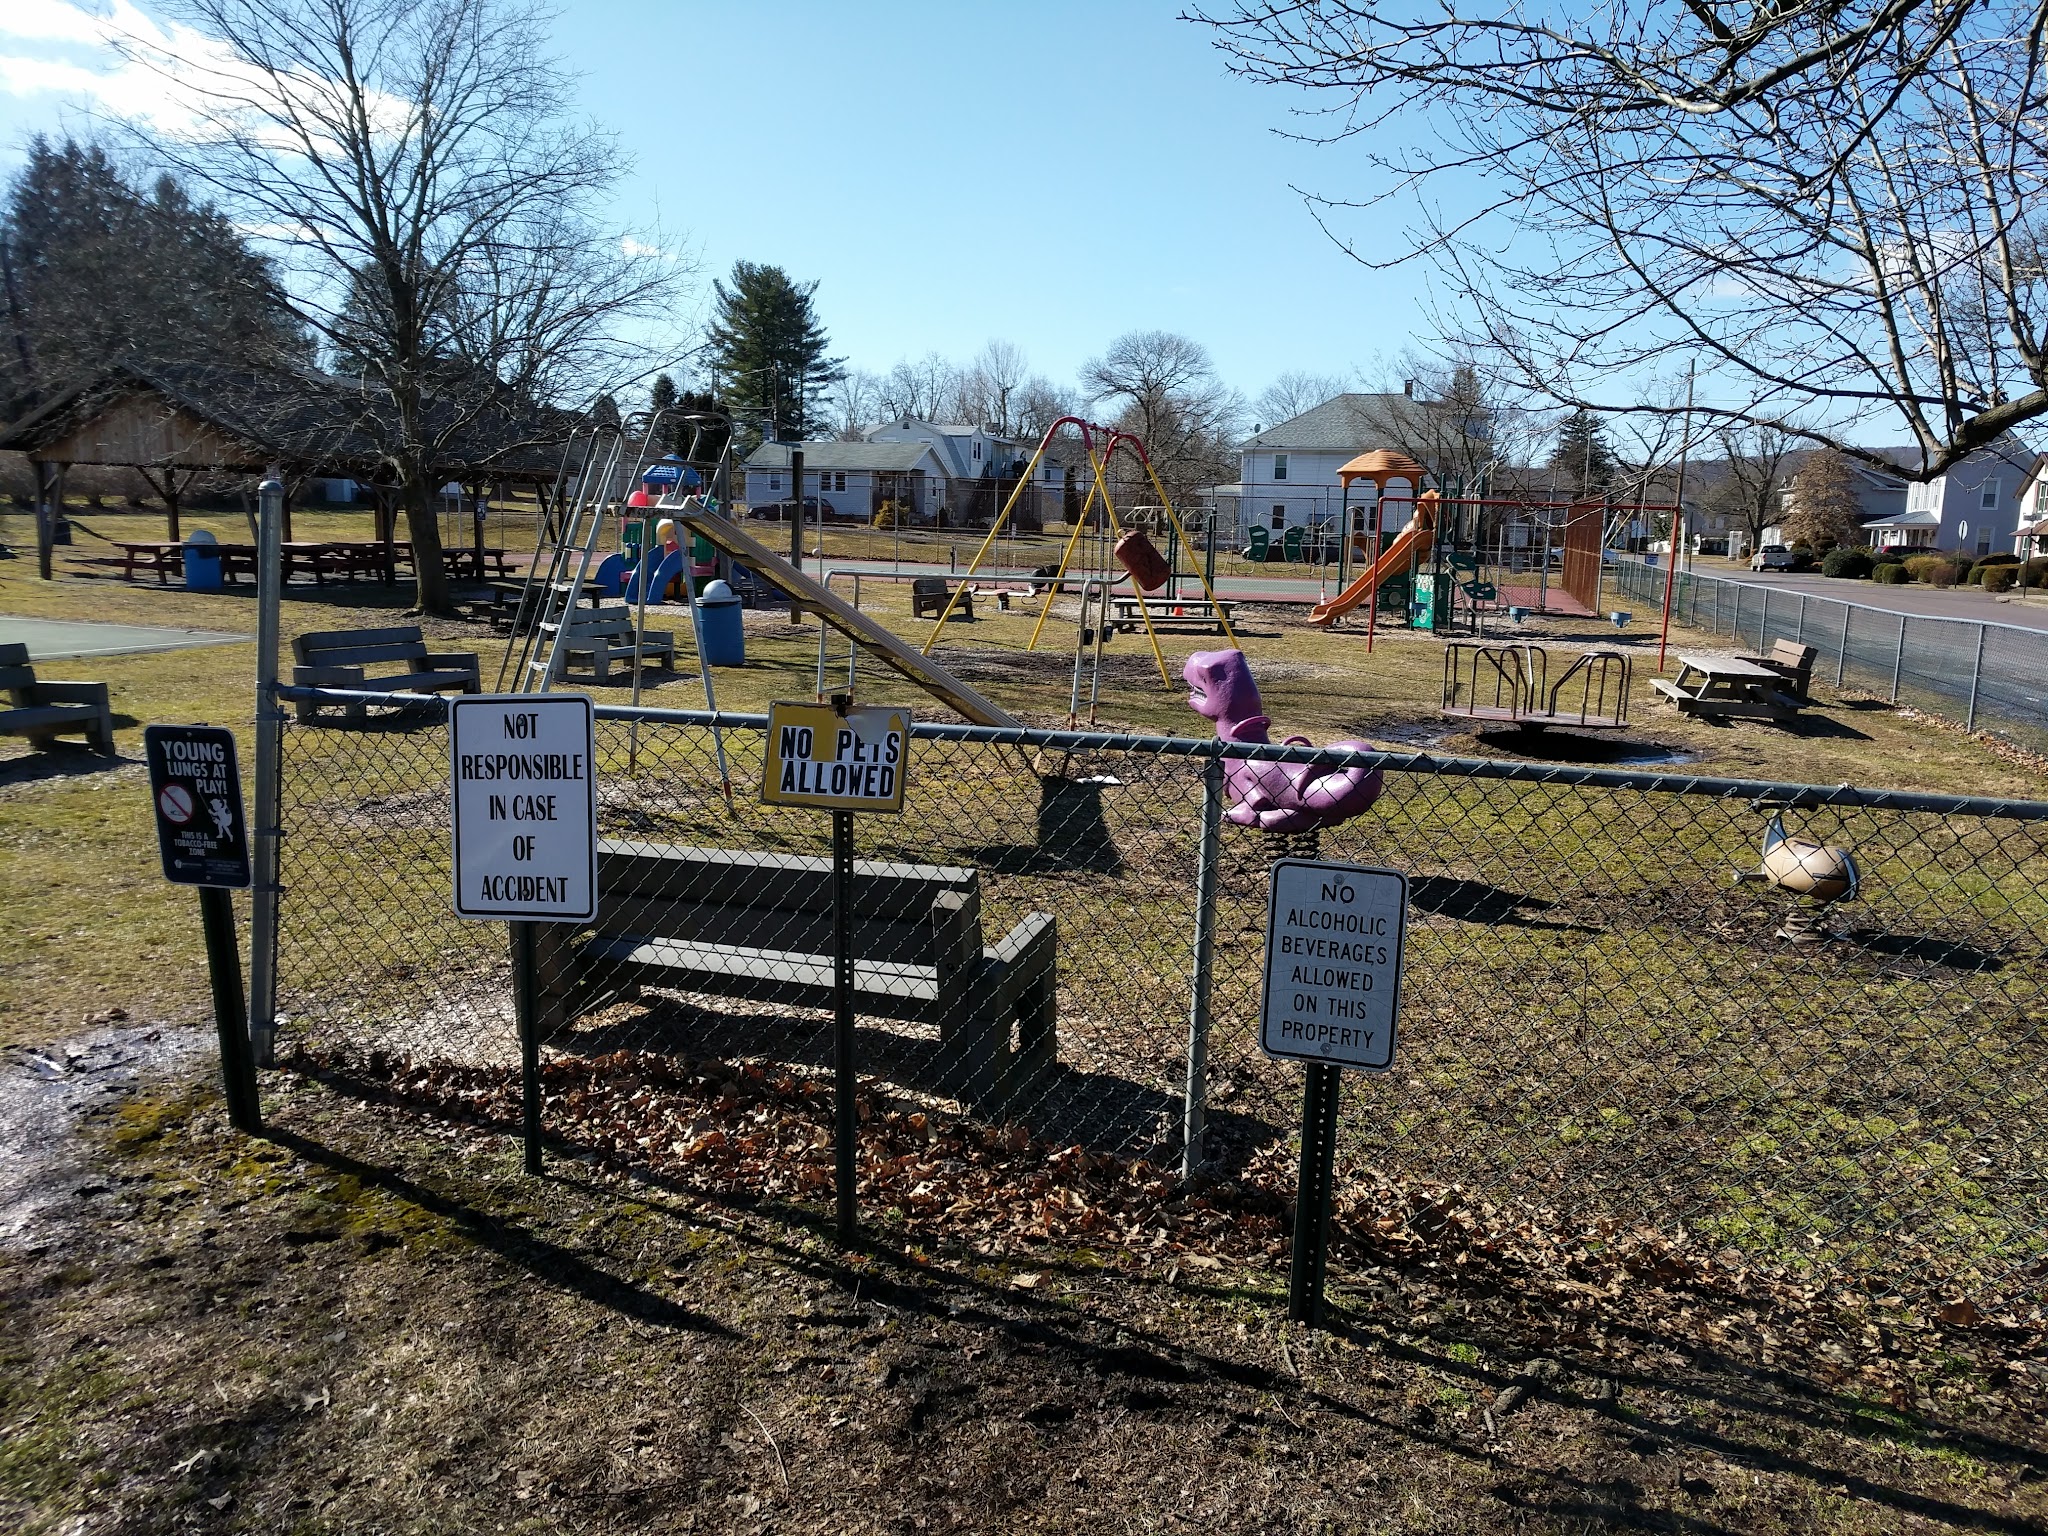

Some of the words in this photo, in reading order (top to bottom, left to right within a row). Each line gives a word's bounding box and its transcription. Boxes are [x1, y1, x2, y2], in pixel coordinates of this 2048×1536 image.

[504, 713, 539, 740] NOT
[160, 741, 224, 762] YOUNG
[780, 727, 813, 759] NO
[167, 761, 208, 777] LUNGS
[212, 764, 227, 778] AT
[461, 754, 584, 780] RESPONSIBLE
[780, 760, 895, 798] ALLOWED
[196, 779, 228, 795] PLAY!
[489, 795, 506, 821] IN
[512, 795, 558, 821] CASE
[174, 838, 218, 850] TOBACCO-FREE
[181, 831, 195, 839] THIS
[196, 832, 203, 840] IS
[203, 832, 209, 840] A
[512, 835, 536, 861] OF
[189, 848, 206, 857] ZONE
[480, 875, 568, 903] ACCIDENT
[1321, 883, 1355, 904] NO
[1286, 908, 1388, 936] ALCOHOLIC
[1281, 935, 1388, 965] BEVERAGES
[1291, 966, 1374, 991] ALLOWED
[1293, 993, 1318, 1014] ON
[1328, 998, 1367, 1020] THIS
[1281, 1020, 1375, 1049] PROPERTY
